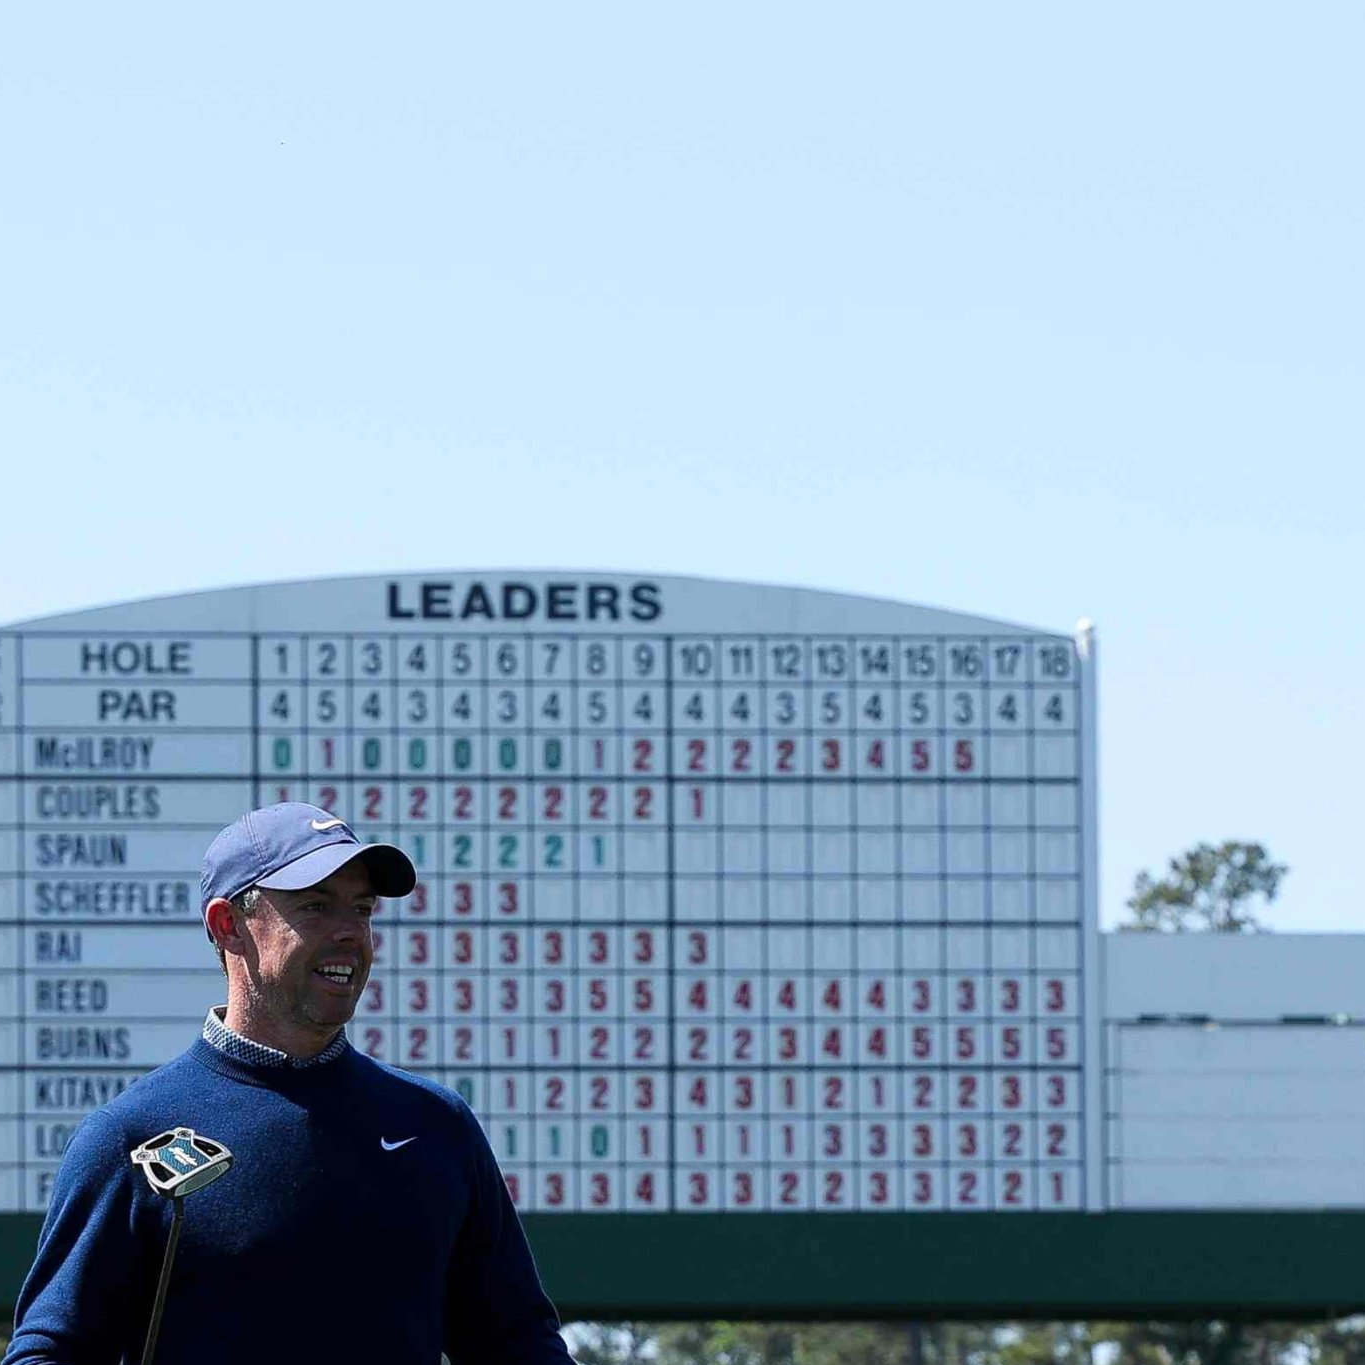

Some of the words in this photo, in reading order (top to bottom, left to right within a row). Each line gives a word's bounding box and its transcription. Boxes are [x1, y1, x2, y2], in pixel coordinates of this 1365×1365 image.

[388, 582, 661, 622] LEADERS
[82, 642, 190, 674] HOLE
[275, 644, 287, 673] 1
[319, 643, 336, 675] 2
[363, 642, 382, 676] 3
[408, 644, 426, 672] 4
[453, 642, 471, 676] 5
[497, 643, 517, 676] 6
[544, 643, 561, 674] 7
[586, 643, 606, 676] 8
[634, 643, 654, 677] 9
[681, 644, 711, 677] 10
[730, 647, 752, 673] 11
[772, 645, 800, 676] 12
[817, 645, 845, 677] 13
[861, 647, 888, 673] 14
[905, 645, 934, 677] 15
[952, 646, 982, 677] 16
[995, 646, 1021, 675] 17
[1039, 646, 1069, 678] 18
[98, 690, 176, 721] PAR
[272, 691, 289, 719] 4
[318, 690, 336, 723] 5
[363, 692, 381, 719] 4
[409, 689, 427, 723] 3
[453, 692, 471, 720] 4
[499, 690, 517, 724] 3
[543, 692, 560, 720] 4
[588, 691, 607, 724] 5
[634, 693, 652, 721] 4
[685, 693, 703, 721] 4
[731, 693, 750, 721] 4
[776, 691, 795, 725] 3
[822, 692, 841, 725] 5
[865, 694, 882, 721] 4
[910, 692, 929, 725] 5
[955, 692, 973, 726] 3
[998, 694, 1017, 721] 4
[1045, 695, 1063, 722] 4
[36, 738, 152, 770] McILROY
[273, 737, 292, 771] 0
[322, 738, 334, 769] 1
[363, 738, 381, 771] 0
[408, 738, 426, 770] 0
[453, 737, 471, 771] 0
[499, 738, 517, 771] 0
[544, 738, 562, 771] 0
[592, 738, 604, 770] 1
[633, 738, 653, 772] 2
[687, 739, 707, 772] 2
[732, 739, 751, 772] 2
[776, 739, 795, 772] 2
[822, 739, 840, 772] 3
[867, 740, 884, 769] 4
[912, 740, 930, 772] 5
[955, 740, 973, 772] 5
[38, 786, 159, 818] COUPLES
[364, 786, 382, 820] 2
[409, 786, 428, 819] 2
[454, 786, 472, 820] 2
[499, 785, 517, 820] 2
[544, 786, 563, 820] 2
[588, 786, 608, 819] 2
[634, 786, 652, 820] 2
[691, 786, 704, 819] 1
[37, 834, 126, 866] SPAUN
[454, 834, 472, 867] 2
[498, 834, 518, 868] 2
[545, 834, 563, 868] 2
[592, 835, 604, 866] 1
[36, 882, 189, 915] SCHEFFLER
[455, 881, 472, 915] 3
[500, 881, 518, 915] 3
[36, 930, 81, 961] RAI
[410, 931, 428, 965] 3
[455, 930, 472, 964] 3
[500, 931, 519, 965] 3
[545, 931, 563, 965] 3
[590, 931, 608, 964] 3
[634, 931, 653, 964] 3
[689, 931, 707, 965] 3
[36, 979, 107, 1012] REED
[410, 979, 428, 1012] 3
[456, 979, 473, 1013] 3
[501, 978, 518, 1012] 3
[546, 980, 564, 1013] 3
[589, 979, 607, 1012] 5
[635, 978, 653, 1013] 5
[689, 980, 707, 1011] 4
[734, 980, 751, 1010] 4
[778, 980, 796, 1010] 4
[823, 980, 841, 1011] 4
[868, 980, 885, 1010] 4
[913, 980, 930, 1013] 3
[958, 978, 975, 1012] 3
[1002, 980, 1019, 1012] 3
[1047, 980, 1064, 1012] 3
[38, 1028, 129, 1059] BURNS
[364, 1027, 384, 1060] 2
[409, 1027, 428, 1060] 2
[455, 1027, 472, 1060] 2
[503, 1027, 516, 1059] 1
[547, 1026, 560, 1059] 1
[590, 1027, 609, 1060] 2
[634, 1027, 653, 1060] 2
[689, 1027, 707, 1061] 2
[734, 1028, 752, 1061] 2
[779, 1027, 797, 1061] 3
[823, 1028, 841, 1058] 4
[868, 1027, 886, 1057] 4
[913, 1026, 931, 1059] 5
[957, 1027, 975, 1060] 5
[1002, 1027, 1020, 1060] 5
[1047, 1027, 1066, 1060] 5
[505, 1077, 516, 1109] 1
[545, 1077, 564, 1110] 2
[591, 1076, 609, 1110] 2
[636, 1076, 654, 1110] 3
[689, 1076, 707, 1107] 4
[735, 1076, 753, 1110] 3
[781, 1075, 795, 1108] 1
[824, 1076, 843, 1109] 2
[871, 1075, 884, 1107] 1
[914, 1075, 933, 1108] 2
[958, 1073, 977, 1108] 2
[1003, 1073, 1021, 1109] 3
[1048, 1075, 1065, 1108] 3
[591, 1125, 609, 1158] 0
[639, 1125, 651, 1157] 1
[824, 1124, 842, 1157] 3
[869, 1124, 887, 1157] 3
[914, 1124, 932, 1157] 3
[959, 1123, 977, 1157] 3
[1003, 1123, 1022, 1156] 2
[1047, 1123, 1065, 1157] 2
